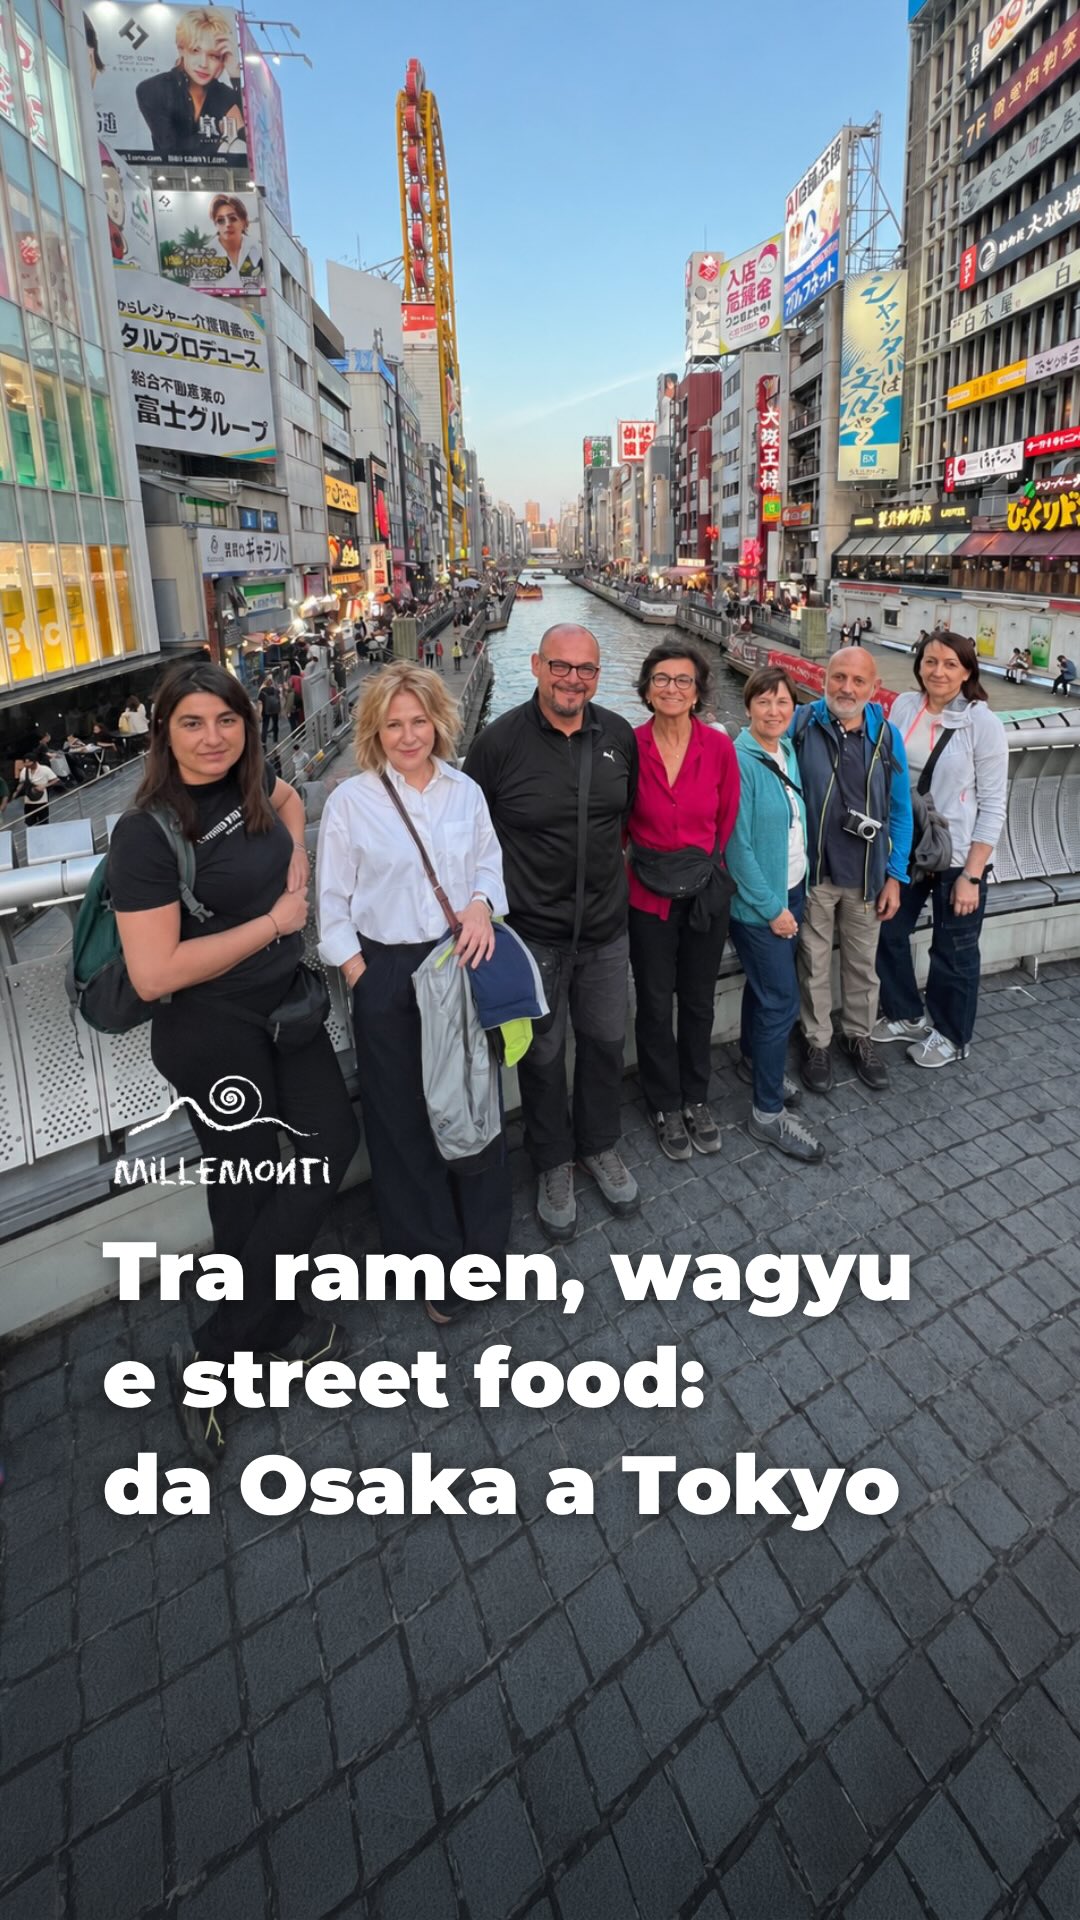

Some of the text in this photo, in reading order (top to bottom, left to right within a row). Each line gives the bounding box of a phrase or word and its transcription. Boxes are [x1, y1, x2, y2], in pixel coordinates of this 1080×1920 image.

[966, 112, 987, 148] 7F
[727, 259, 757, 291] 入店
[1056, 261, 1080, 288] 白
[121, 322, 260, 369] タルプロデュース
[134, 394, 269, 442] 富士グループ
